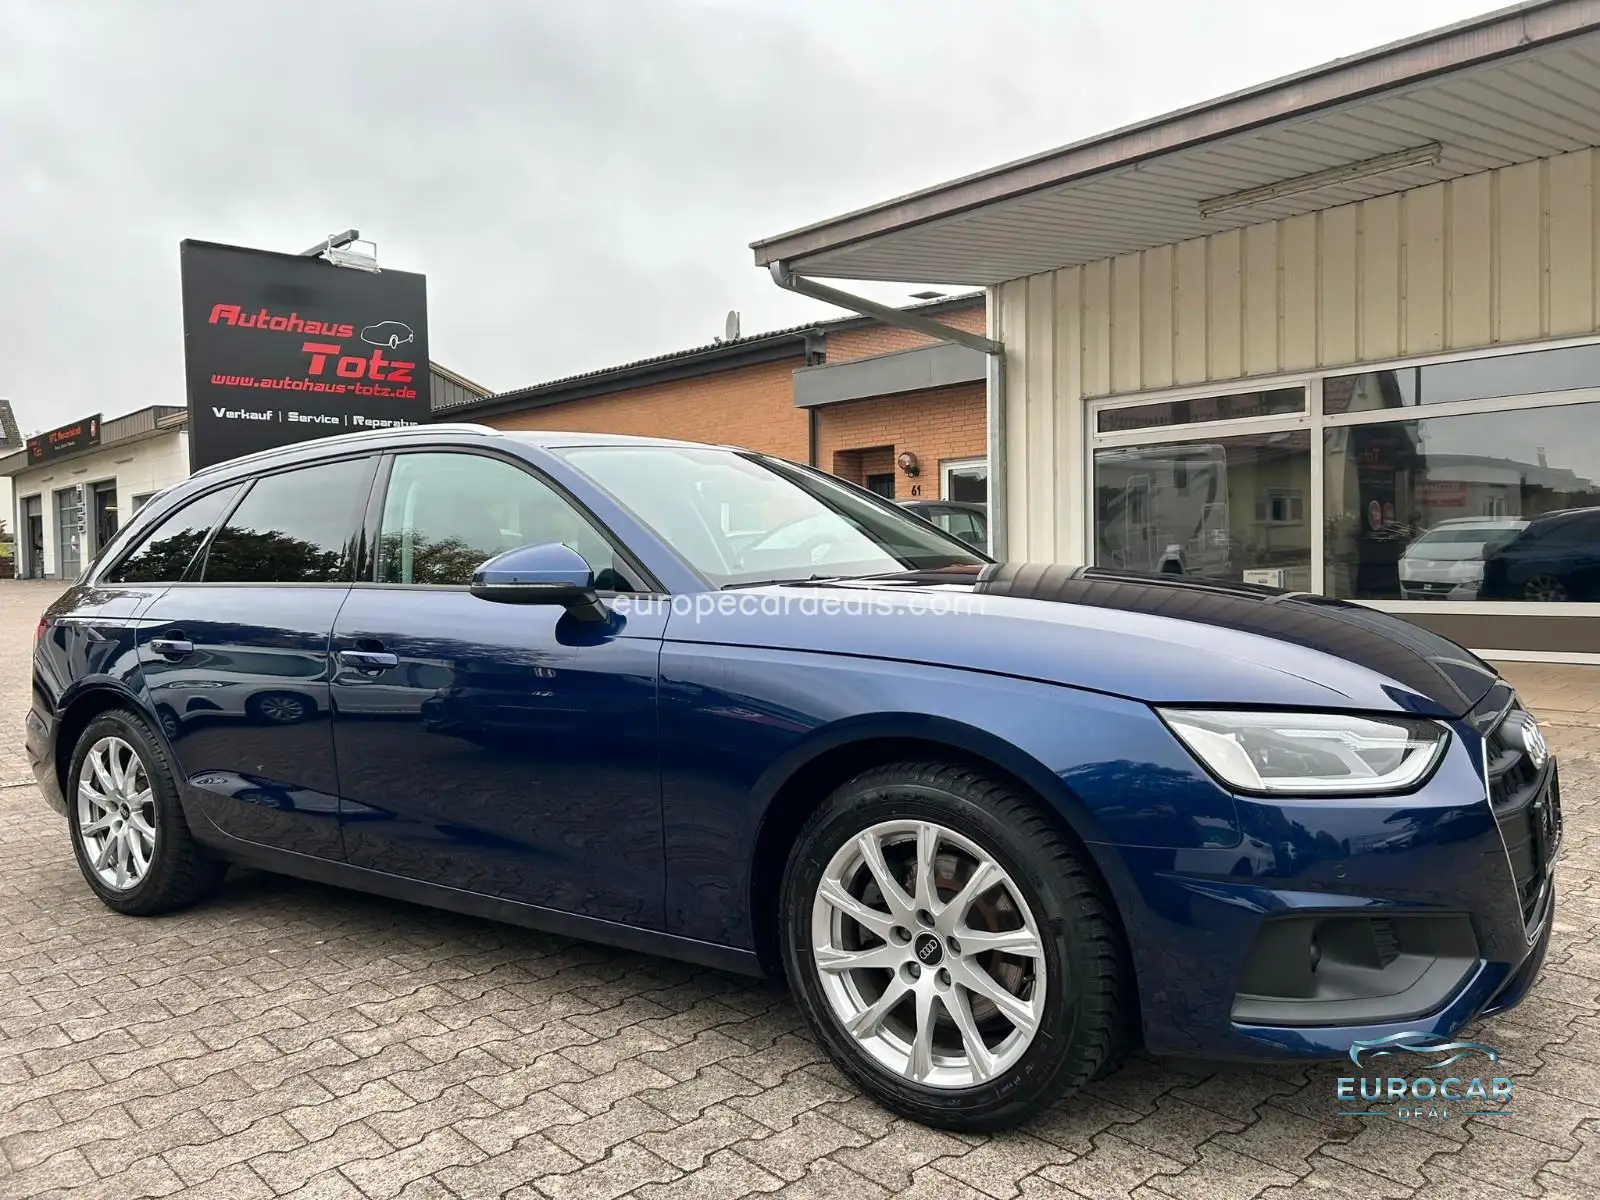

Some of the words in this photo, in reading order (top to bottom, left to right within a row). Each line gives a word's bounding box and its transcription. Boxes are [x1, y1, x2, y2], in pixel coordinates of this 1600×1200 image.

[208, 304, 353, 338] Autohaus
[302, 343, 416, 382] Totz
[211, 374, 417, 398] www.autohaus-totz.de
[212, 406, 273, 421] Verkauf
[287, 411, 340, 425] Service
[911, 485, 922, 496] 61
